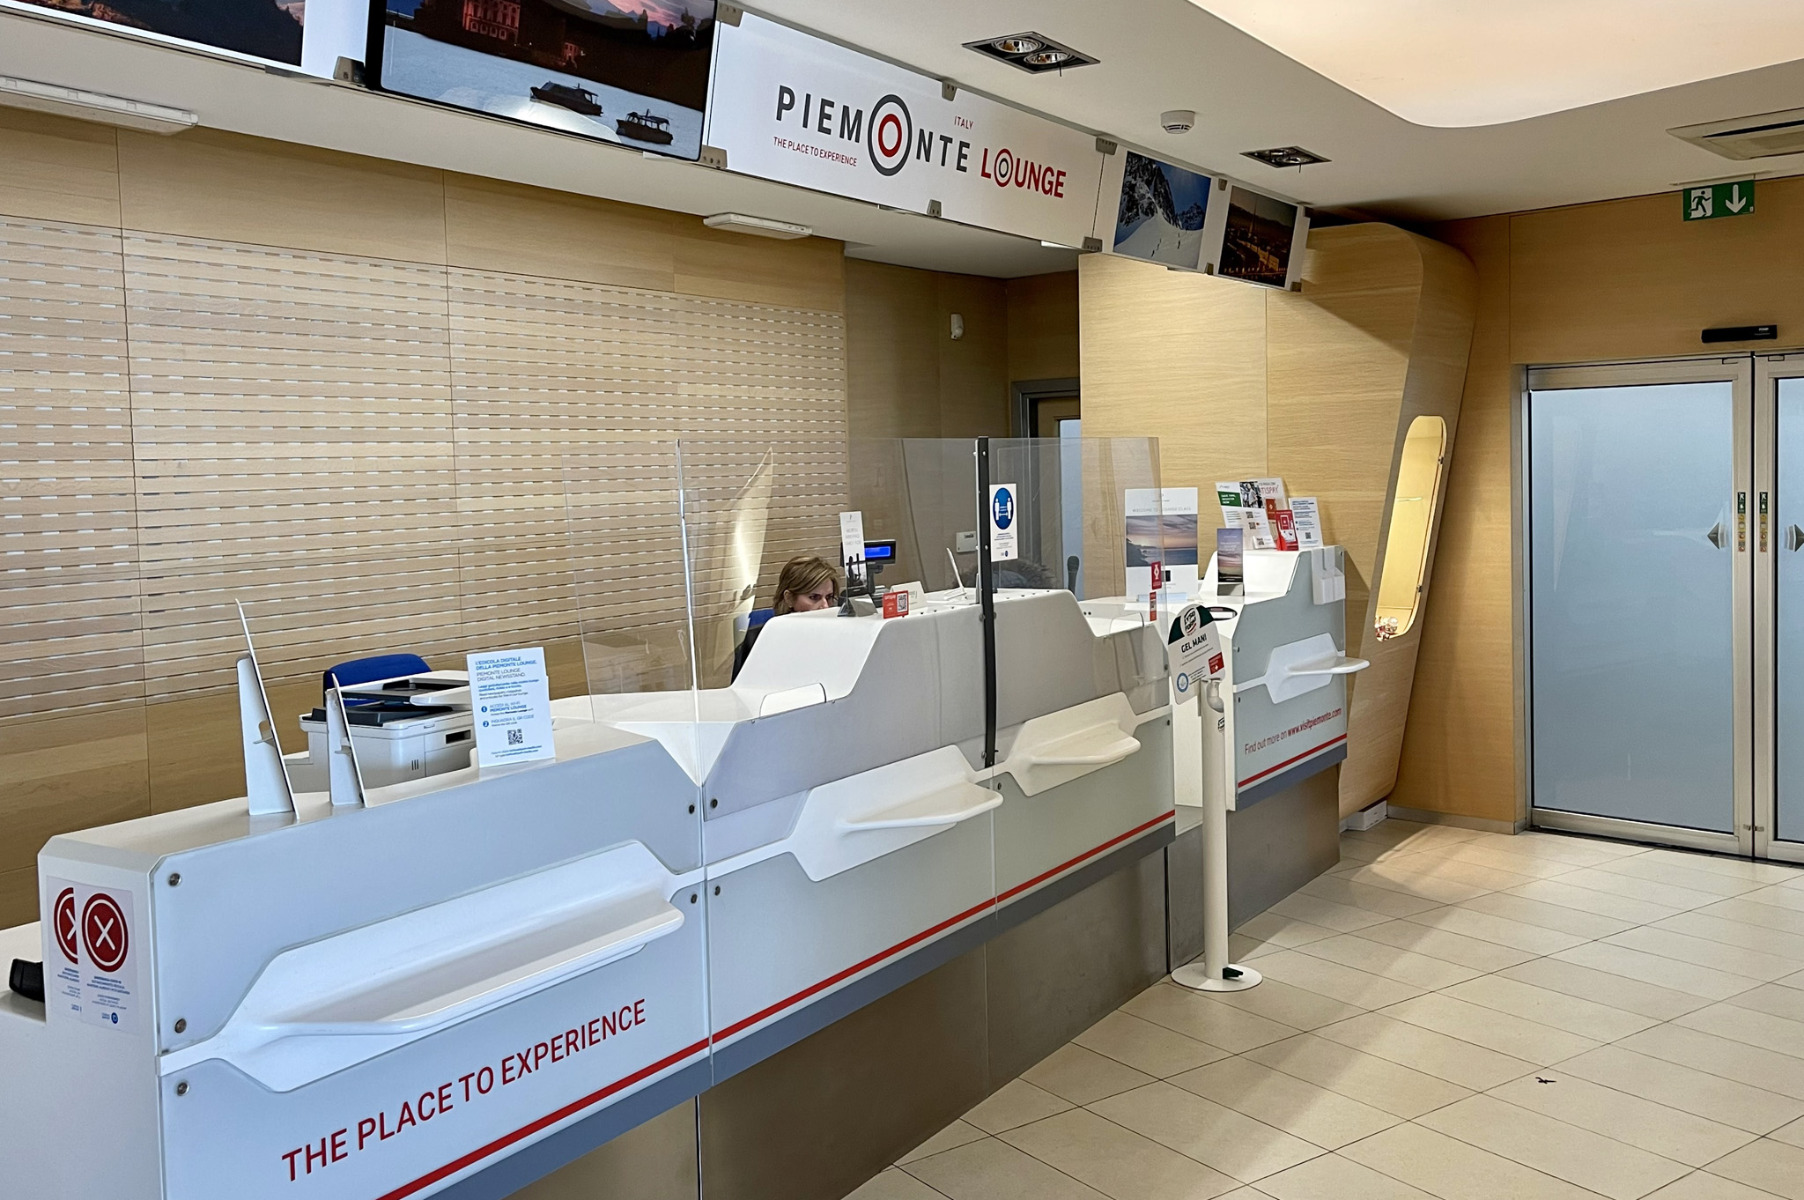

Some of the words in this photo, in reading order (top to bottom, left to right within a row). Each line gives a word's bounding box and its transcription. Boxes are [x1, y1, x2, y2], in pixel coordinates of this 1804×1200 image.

[954, 115, 974, 130] ITALY
[774, 136, 787, 149] THE
[788, 140, 809, 154] PLACE
[810, 146, 819, 157] TO
[819, 149, 857, 167] EXPERIENCE
[776, 85, 970, 177] PIEMONTE
[981, 148, 1067, 198] LOUNGE
[1181, 642, 1192, 653] GEL
[1192, 633, 1208, 648] MANI
[1245, 740, 1257, 755] Find
[1257, 738, 1266, 750] out
[1266, 734, 1280, 745] more
[1280, 731, 1287, 741] on
[281, 1127, 349, 1182] THE
[357, 1082, 454, 1150] PLACE
[458, 1066, 495, 1102] TO
[501, 998, 646, 1085] EXPERIENCE
